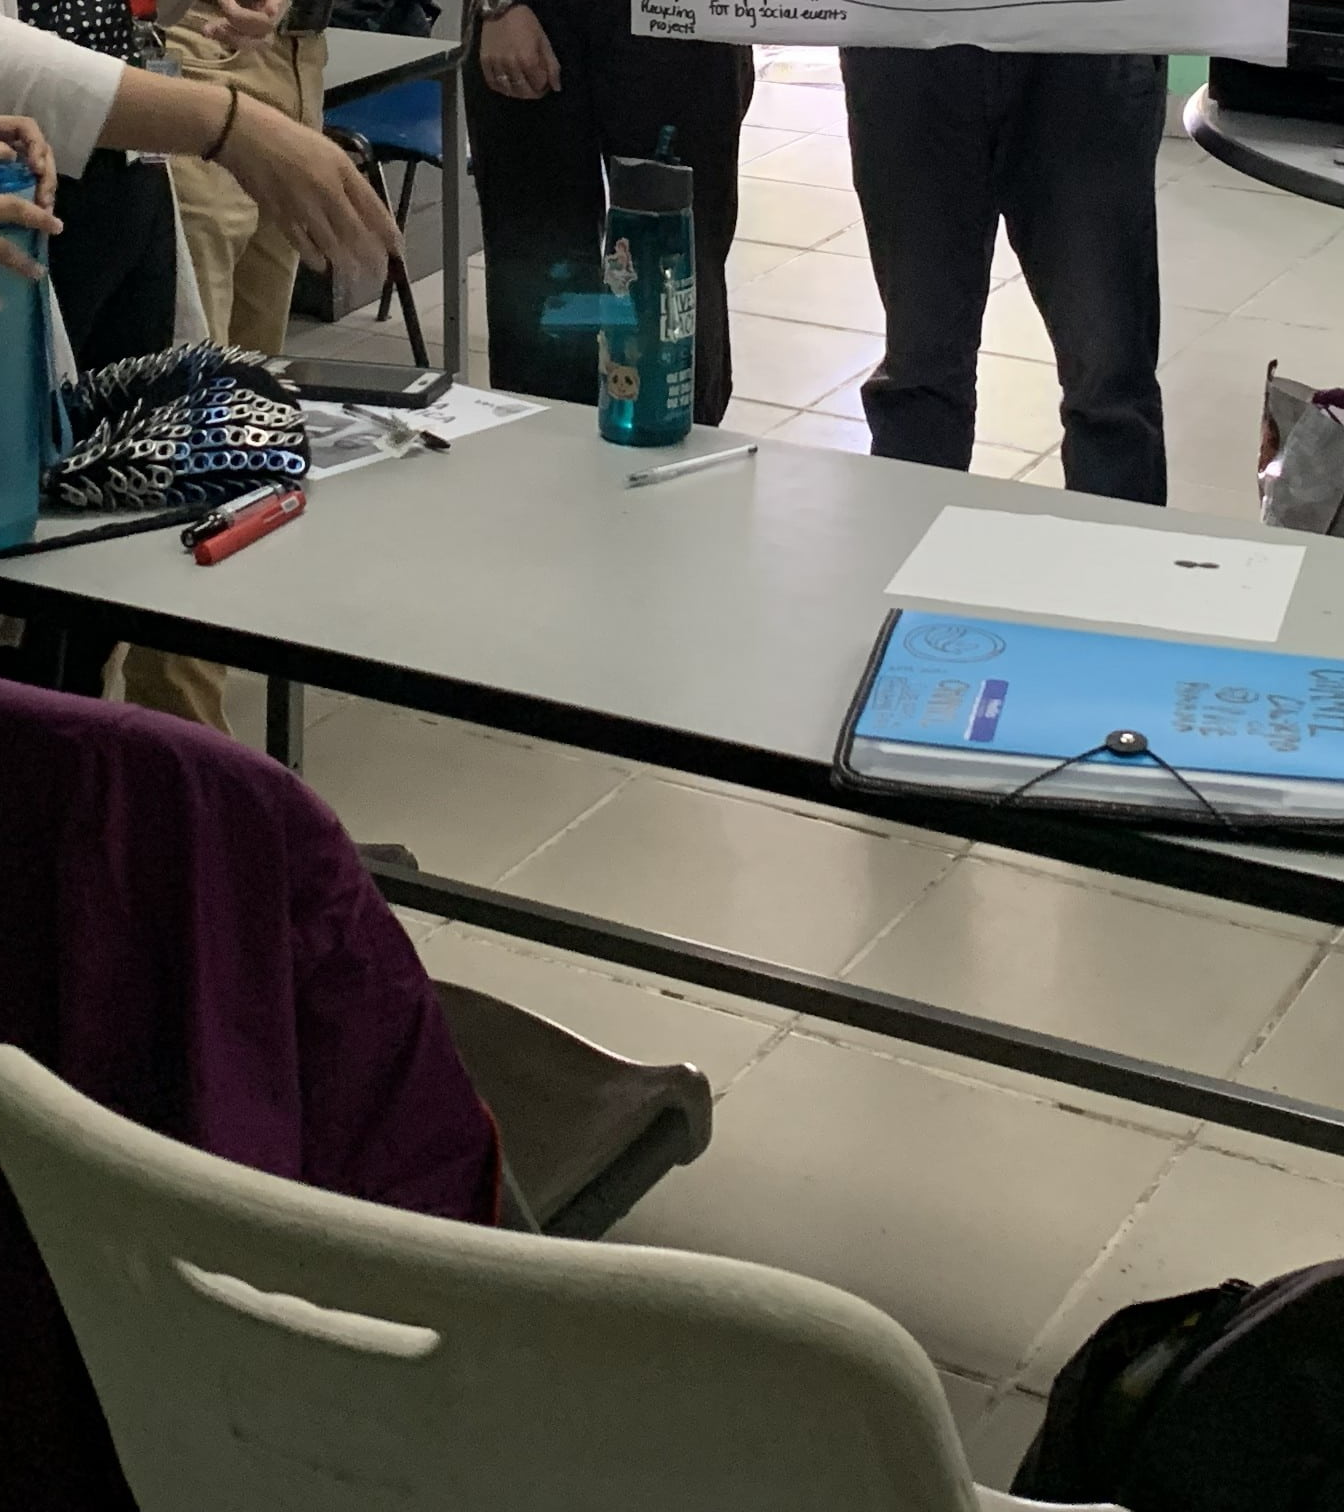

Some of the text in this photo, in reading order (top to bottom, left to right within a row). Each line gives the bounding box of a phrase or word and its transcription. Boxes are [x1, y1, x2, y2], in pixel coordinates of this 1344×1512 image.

[640, 0, 696, 25] Recycling
[735, 4, 756, 28] big
[758, 5, 798, 19] social
[800, 9, 848, 20] events
